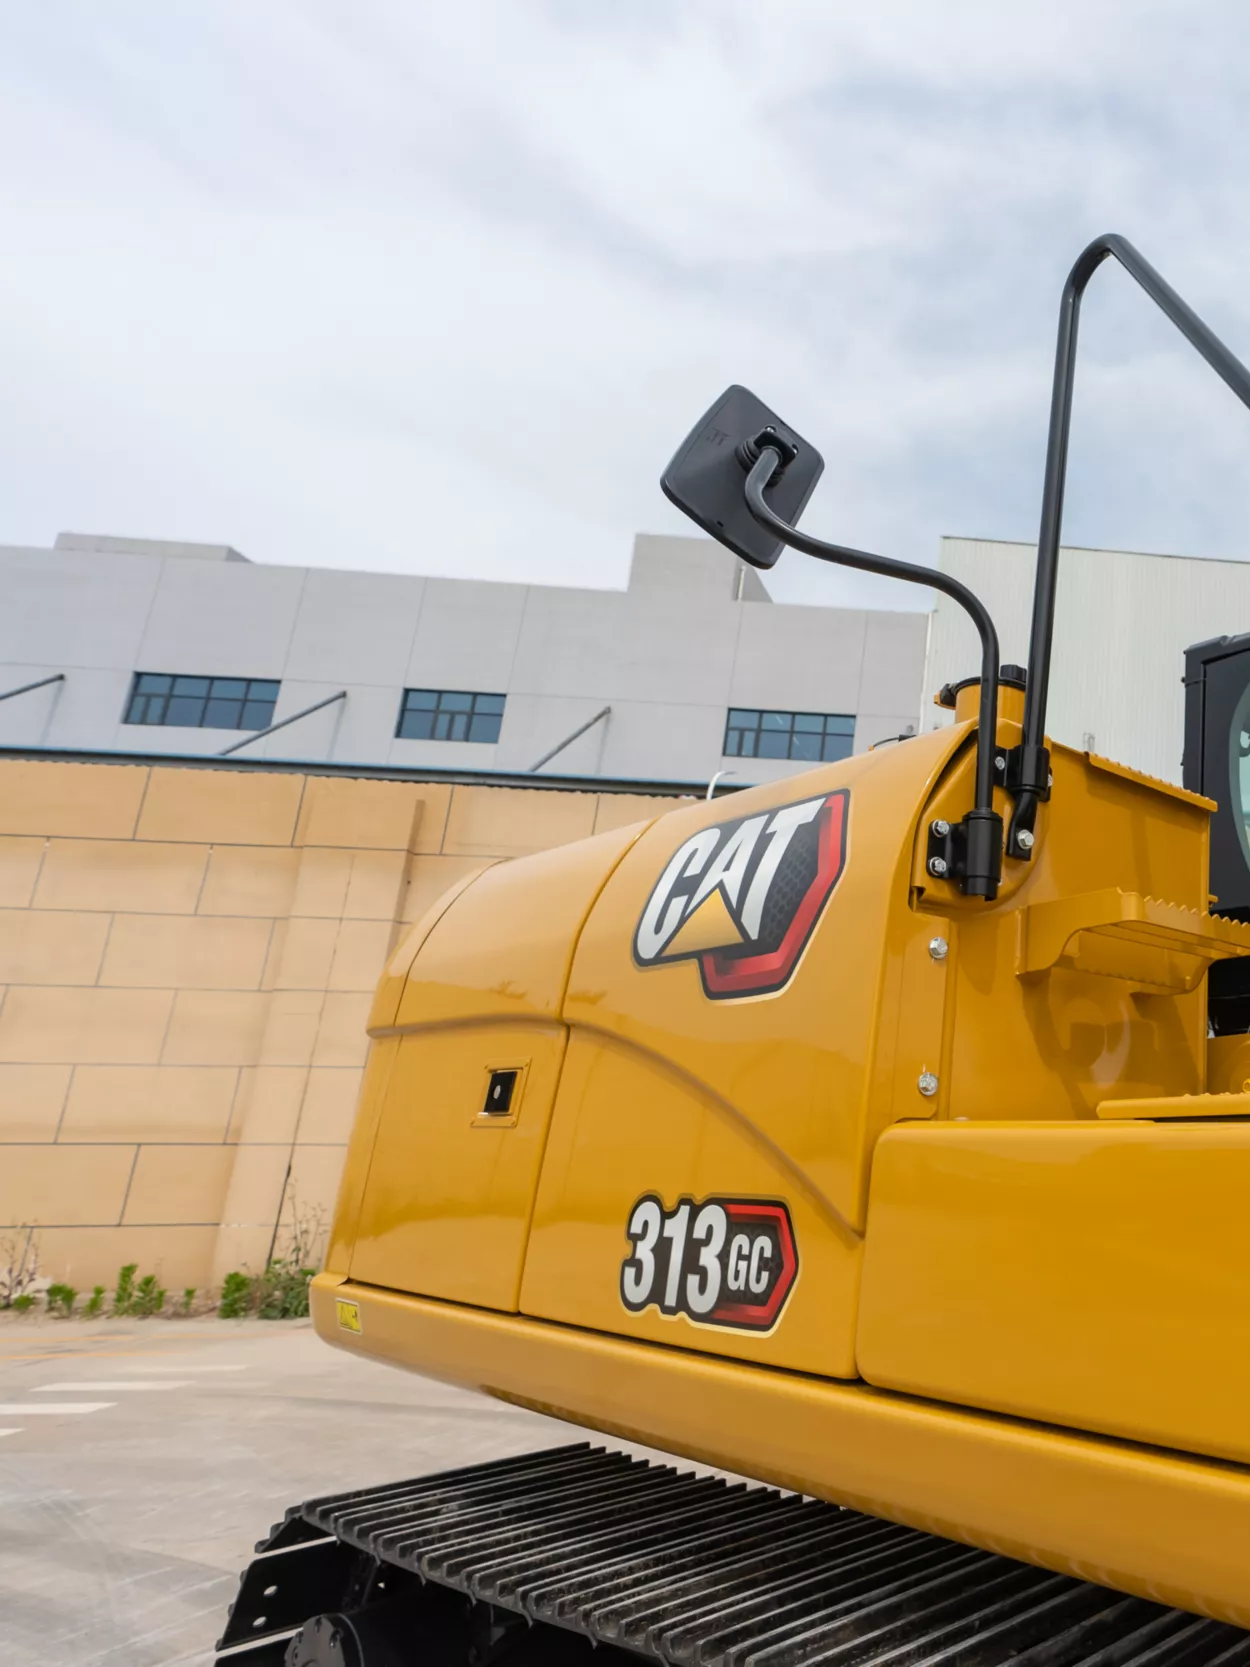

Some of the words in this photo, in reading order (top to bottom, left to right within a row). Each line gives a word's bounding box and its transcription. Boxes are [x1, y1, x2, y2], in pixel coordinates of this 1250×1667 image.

[637, 797, 827, 960] CAT
[623, 1201, 728, 1314] 313
[727, 1233, 773, 1294] GC
